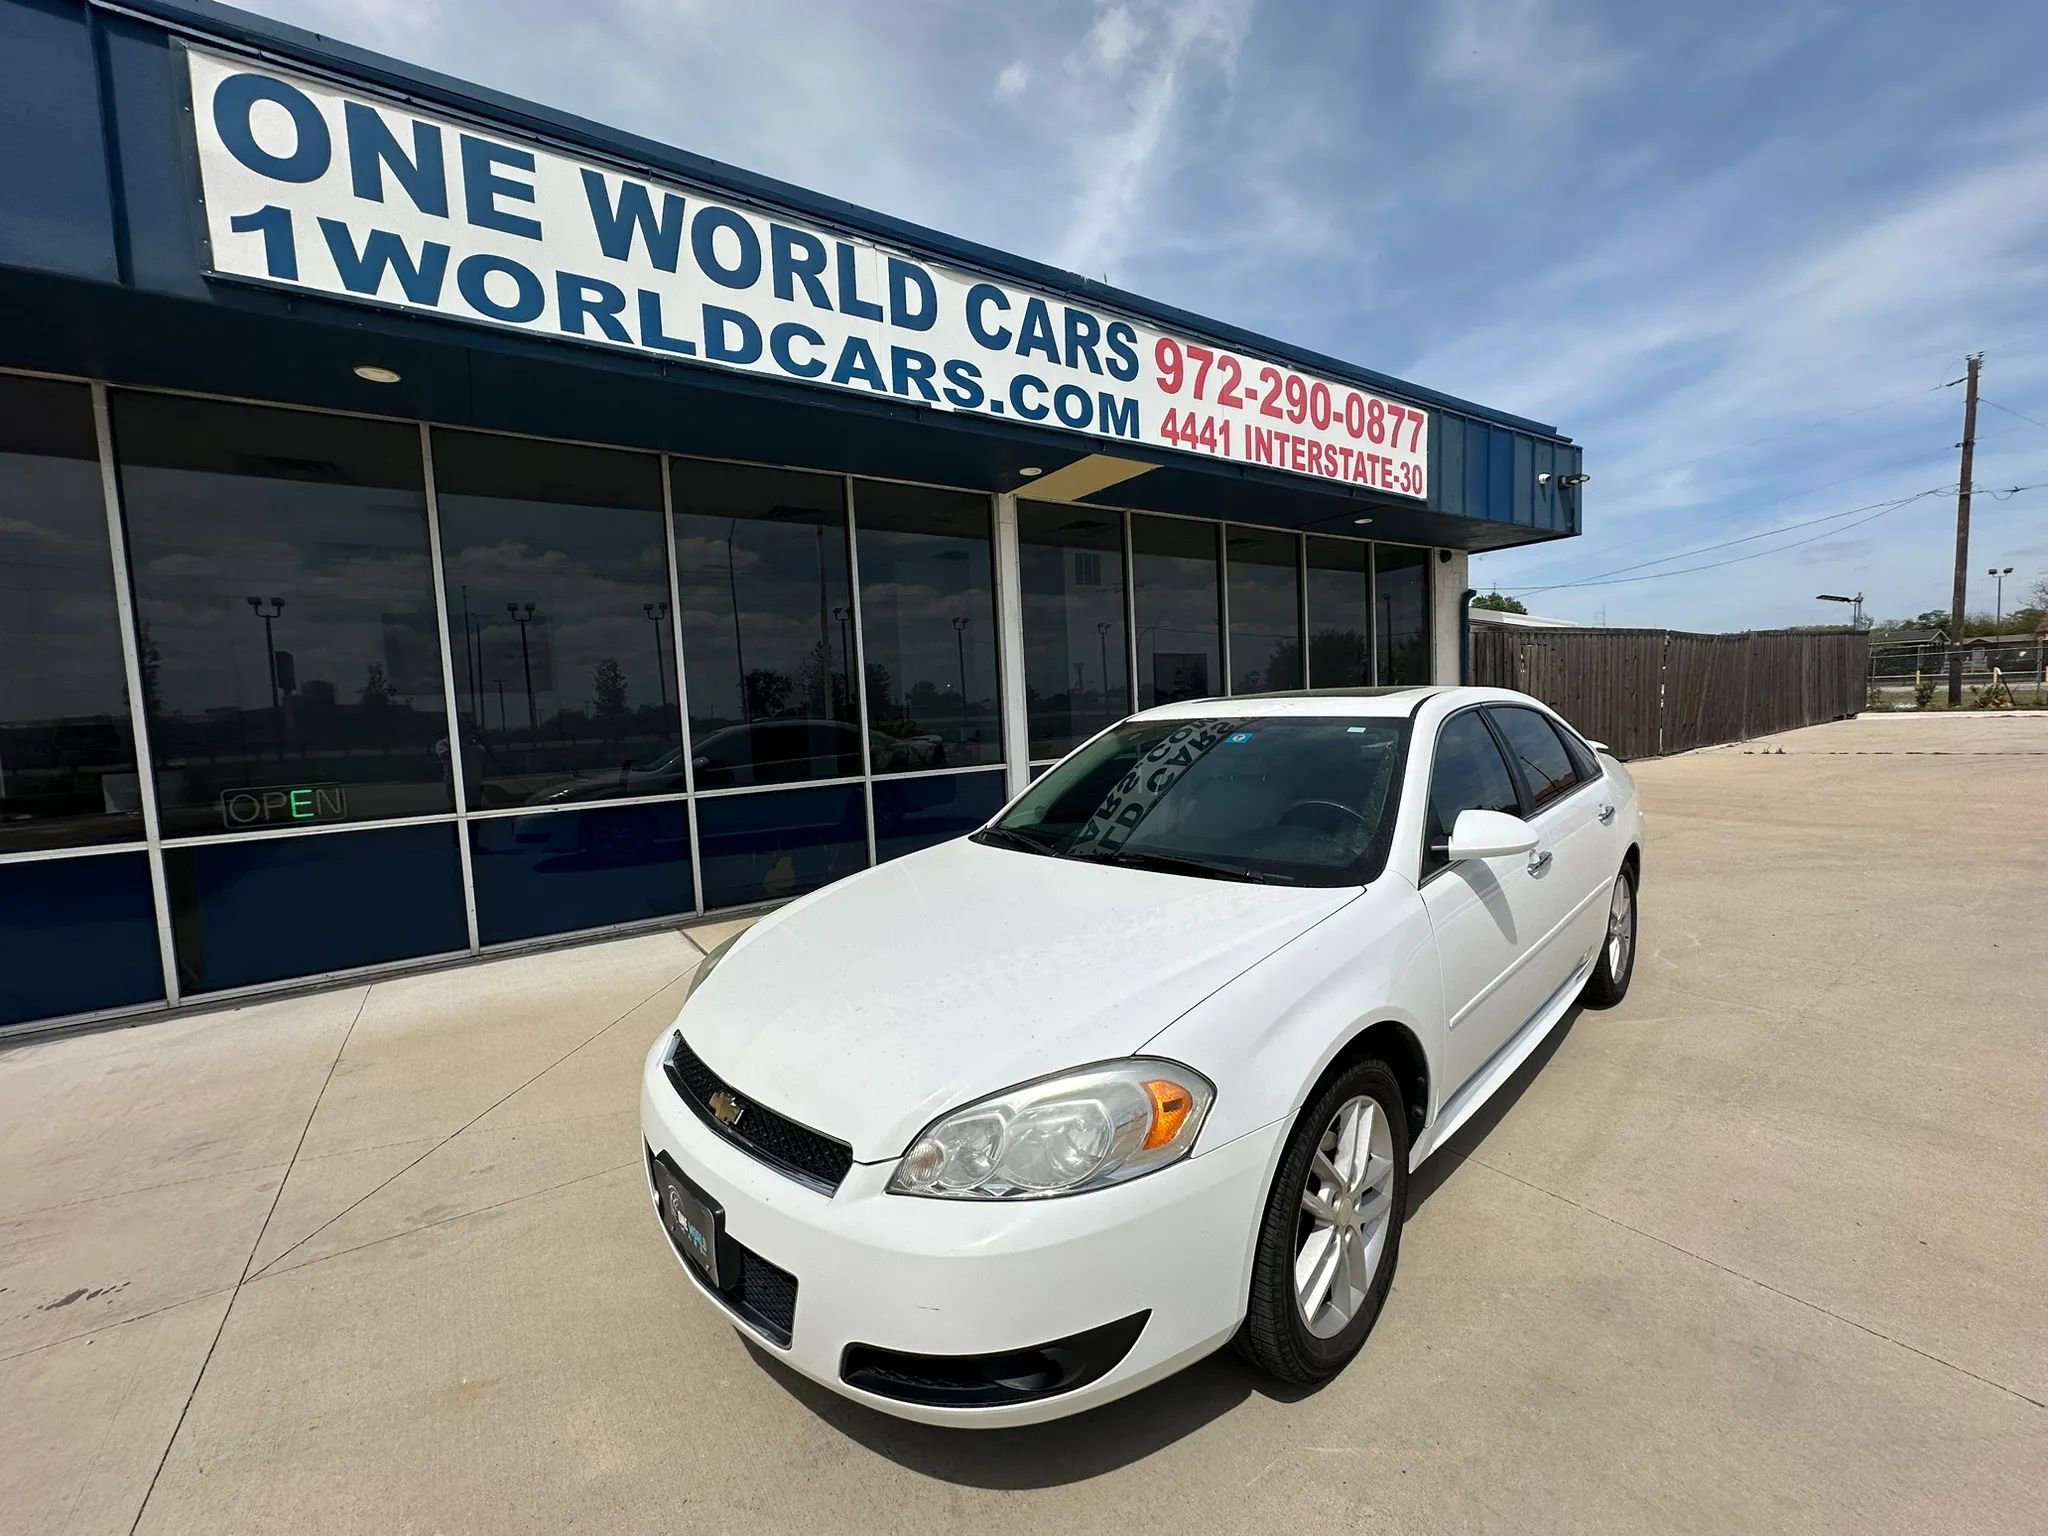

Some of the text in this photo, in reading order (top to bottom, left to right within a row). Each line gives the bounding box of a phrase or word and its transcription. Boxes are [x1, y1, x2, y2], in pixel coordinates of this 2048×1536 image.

[213, 72, 1140, 382] ONE WORLD CARS
[230, 204, 1140, 440] 1WORLDCARS.COM
[1155, 337, 1424, 454] 972-290-0877
[1160, 407, 1424, 496] 4441 INTERSTATE-30
[229, 788, 342, 823] OPEN
